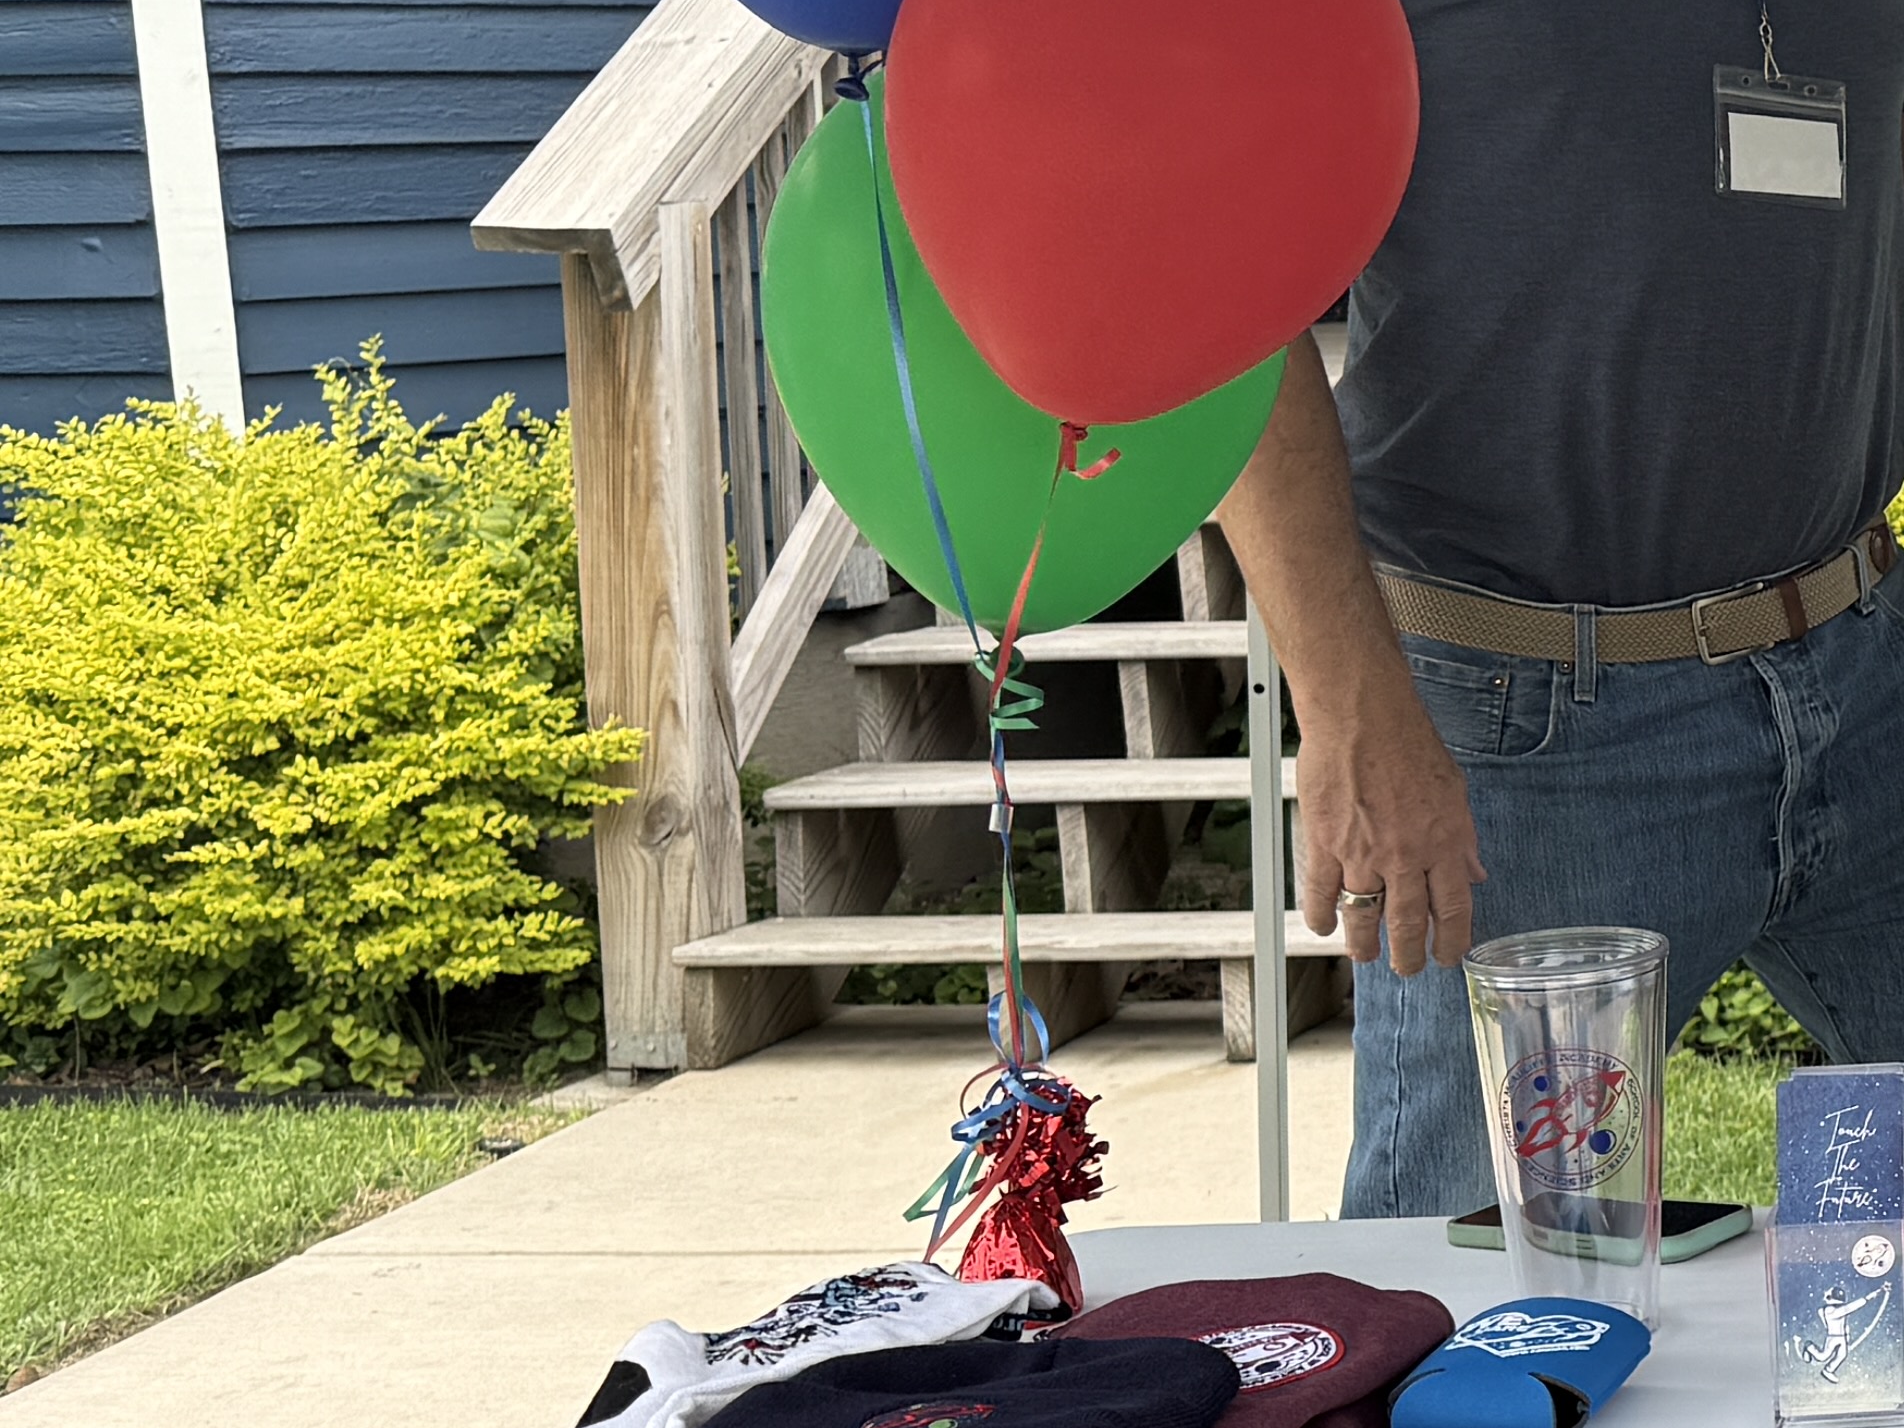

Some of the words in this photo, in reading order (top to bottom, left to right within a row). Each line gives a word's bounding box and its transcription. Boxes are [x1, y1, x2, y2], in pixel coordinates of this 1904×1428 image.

[1825, 1105, 1877, 1154] Touch
[1828, 1140, 1860, 1183] The
[1814, 1176, 1875, 1219] Future
